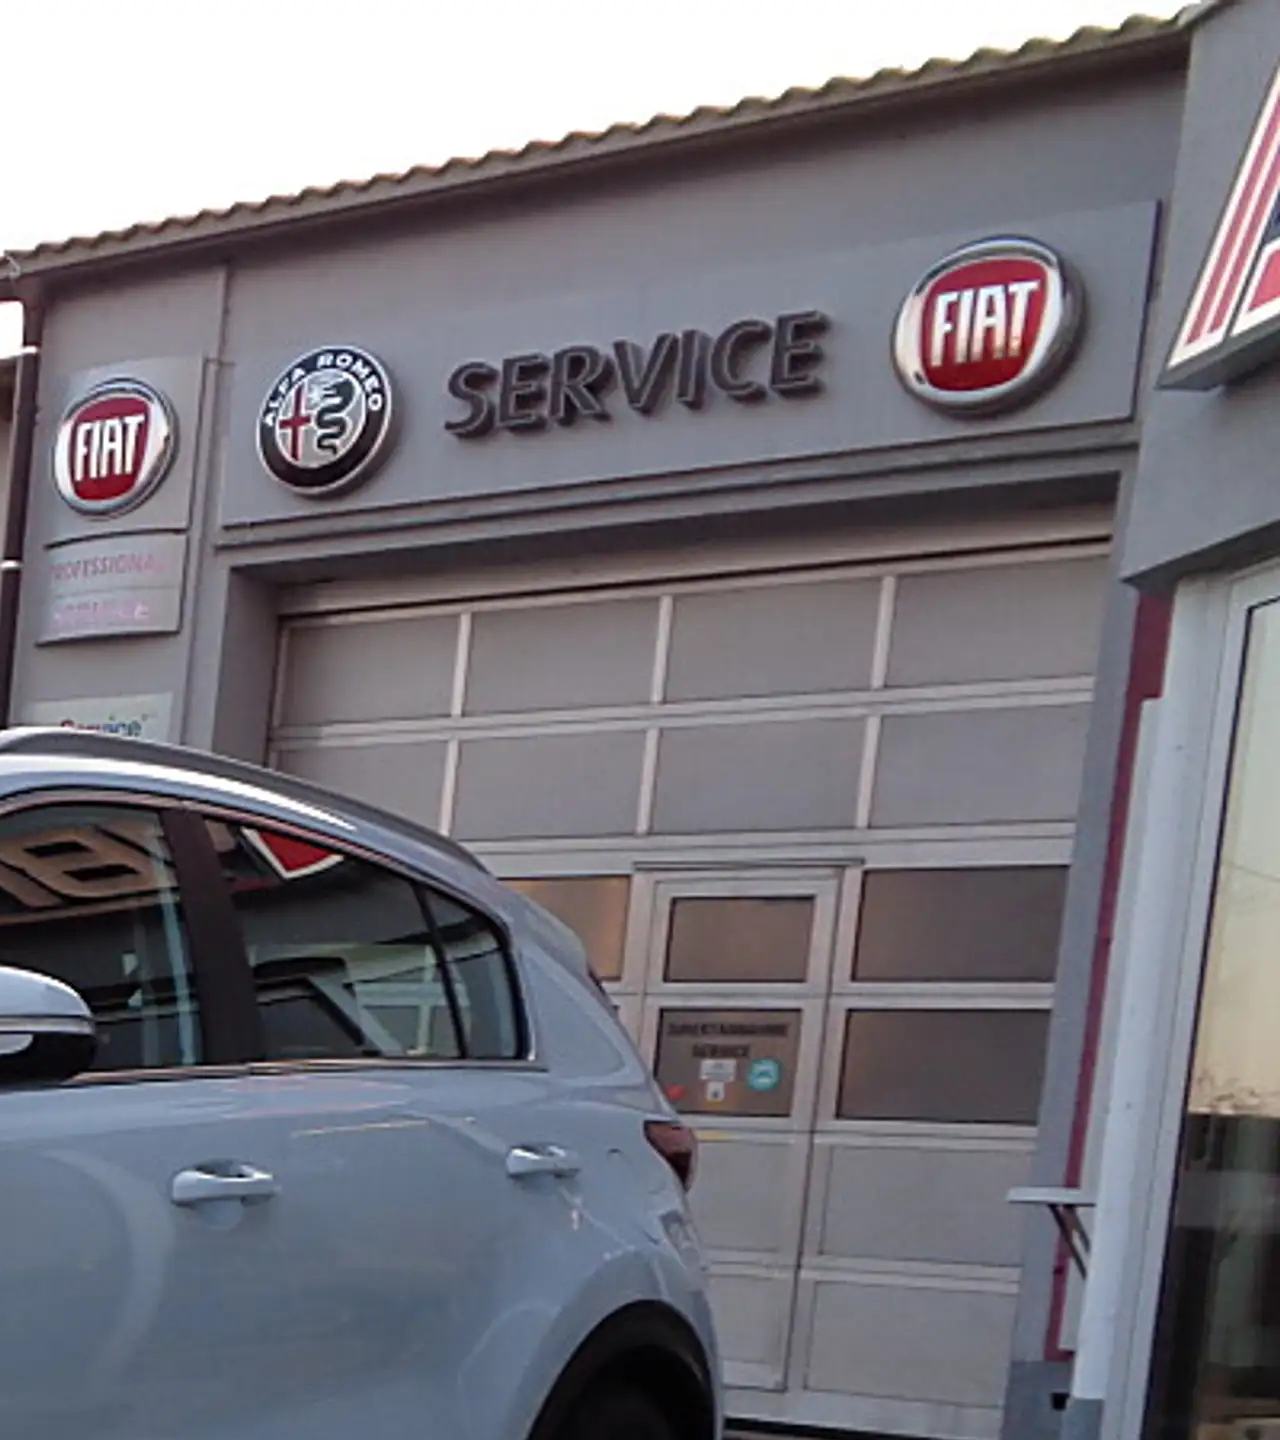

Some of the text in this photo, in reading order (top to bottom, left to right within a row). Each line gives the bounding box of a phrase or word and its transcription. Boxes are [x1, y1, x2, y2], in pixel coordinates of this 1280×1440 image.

[929, 278, 1040, 368] FIAT
[263, 352, 383, 427] ALFA ROMEO
[444, 309, 830, 438] SERVICE
[73, 413, 146, 482] FIAT
